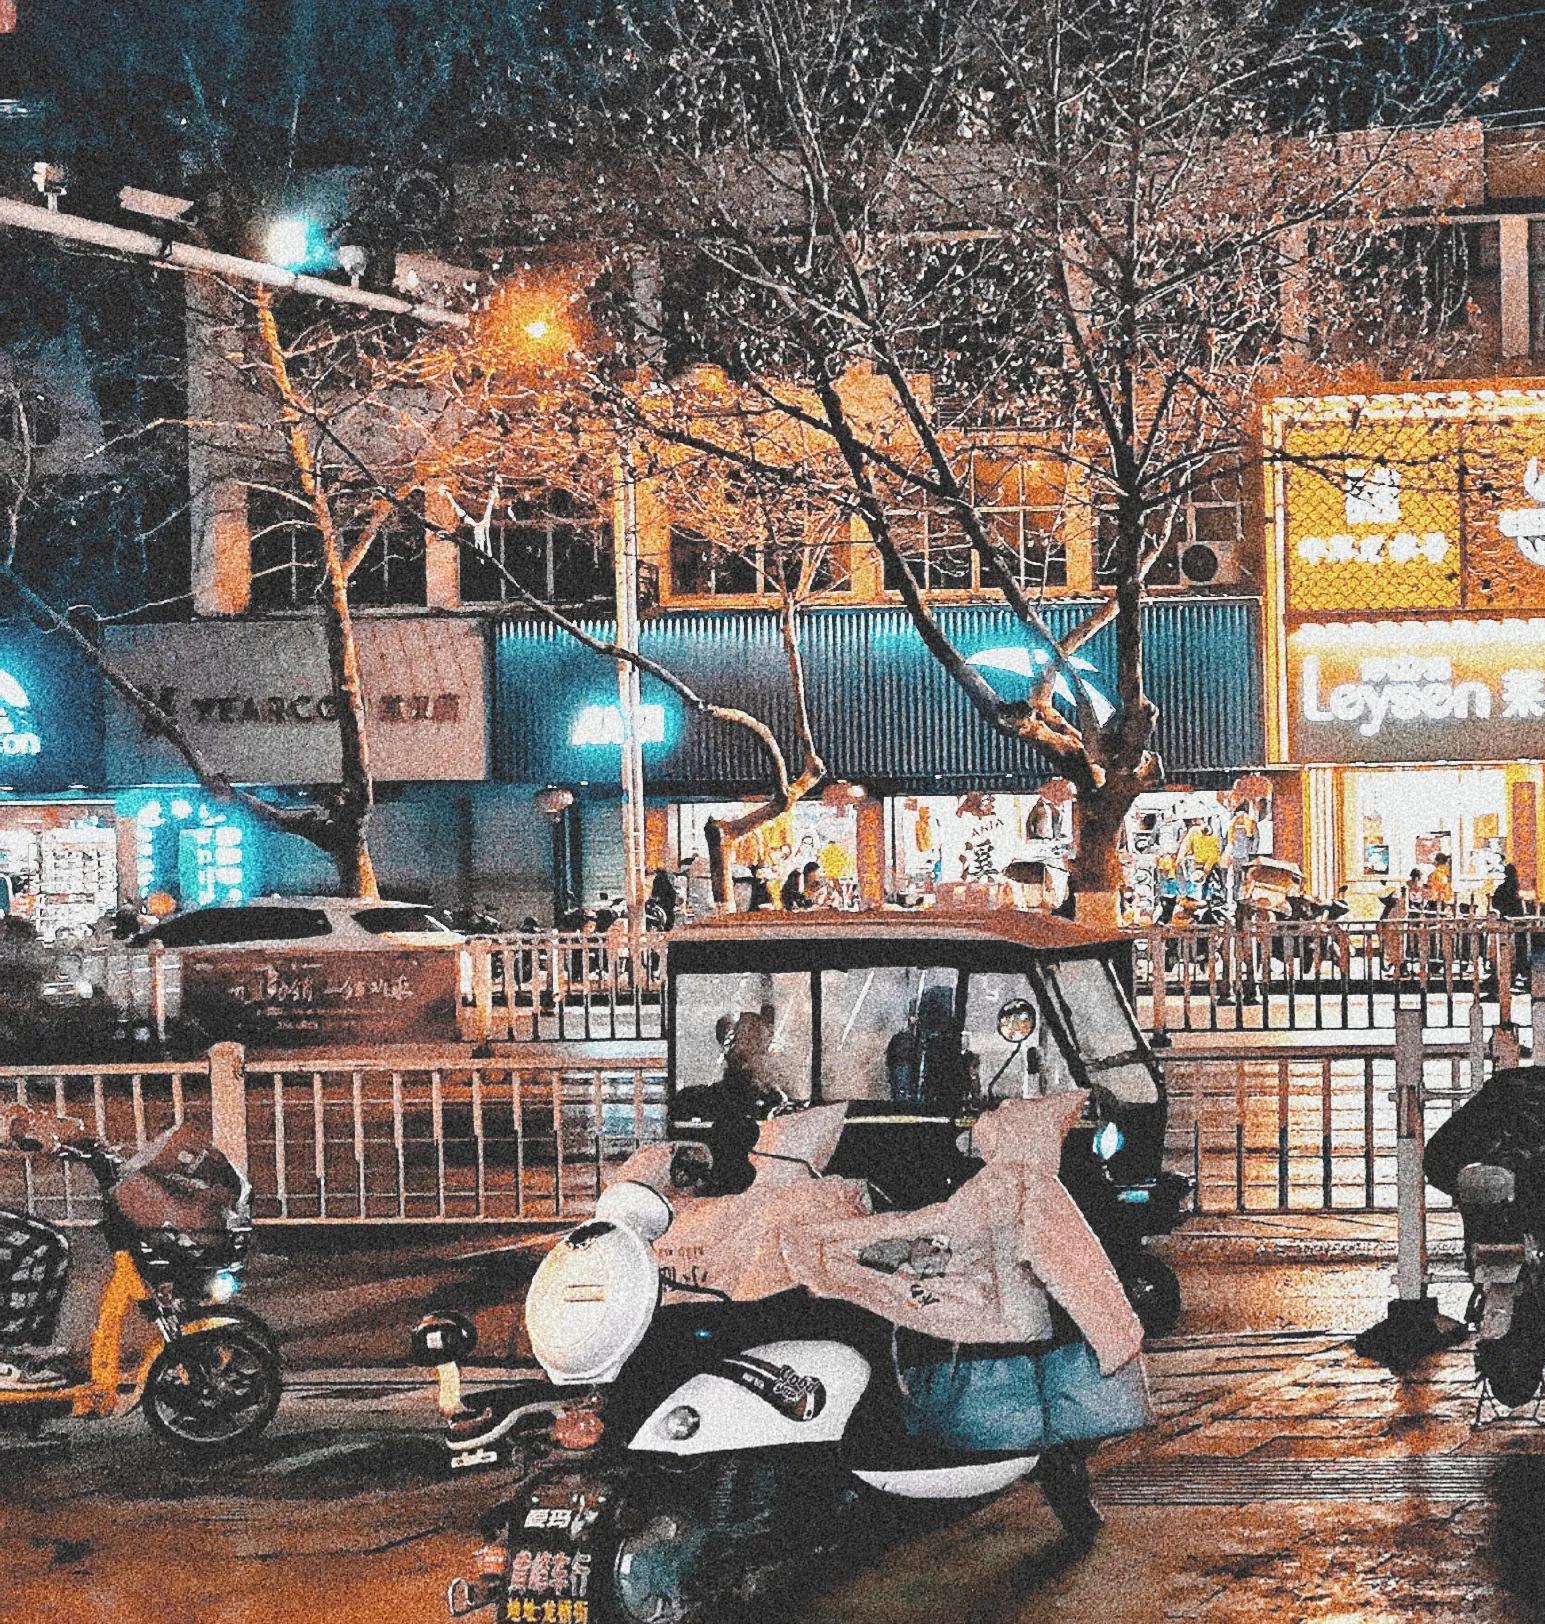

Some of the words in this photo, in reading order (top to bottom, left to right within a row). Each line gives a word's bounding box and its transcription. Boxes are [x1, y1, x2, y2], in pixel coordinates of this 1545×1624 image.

[192, 694, 348, 724] YEARCO
[1302, 654, 1494, 738] Leysen
[0, 732, 42, 756] on
